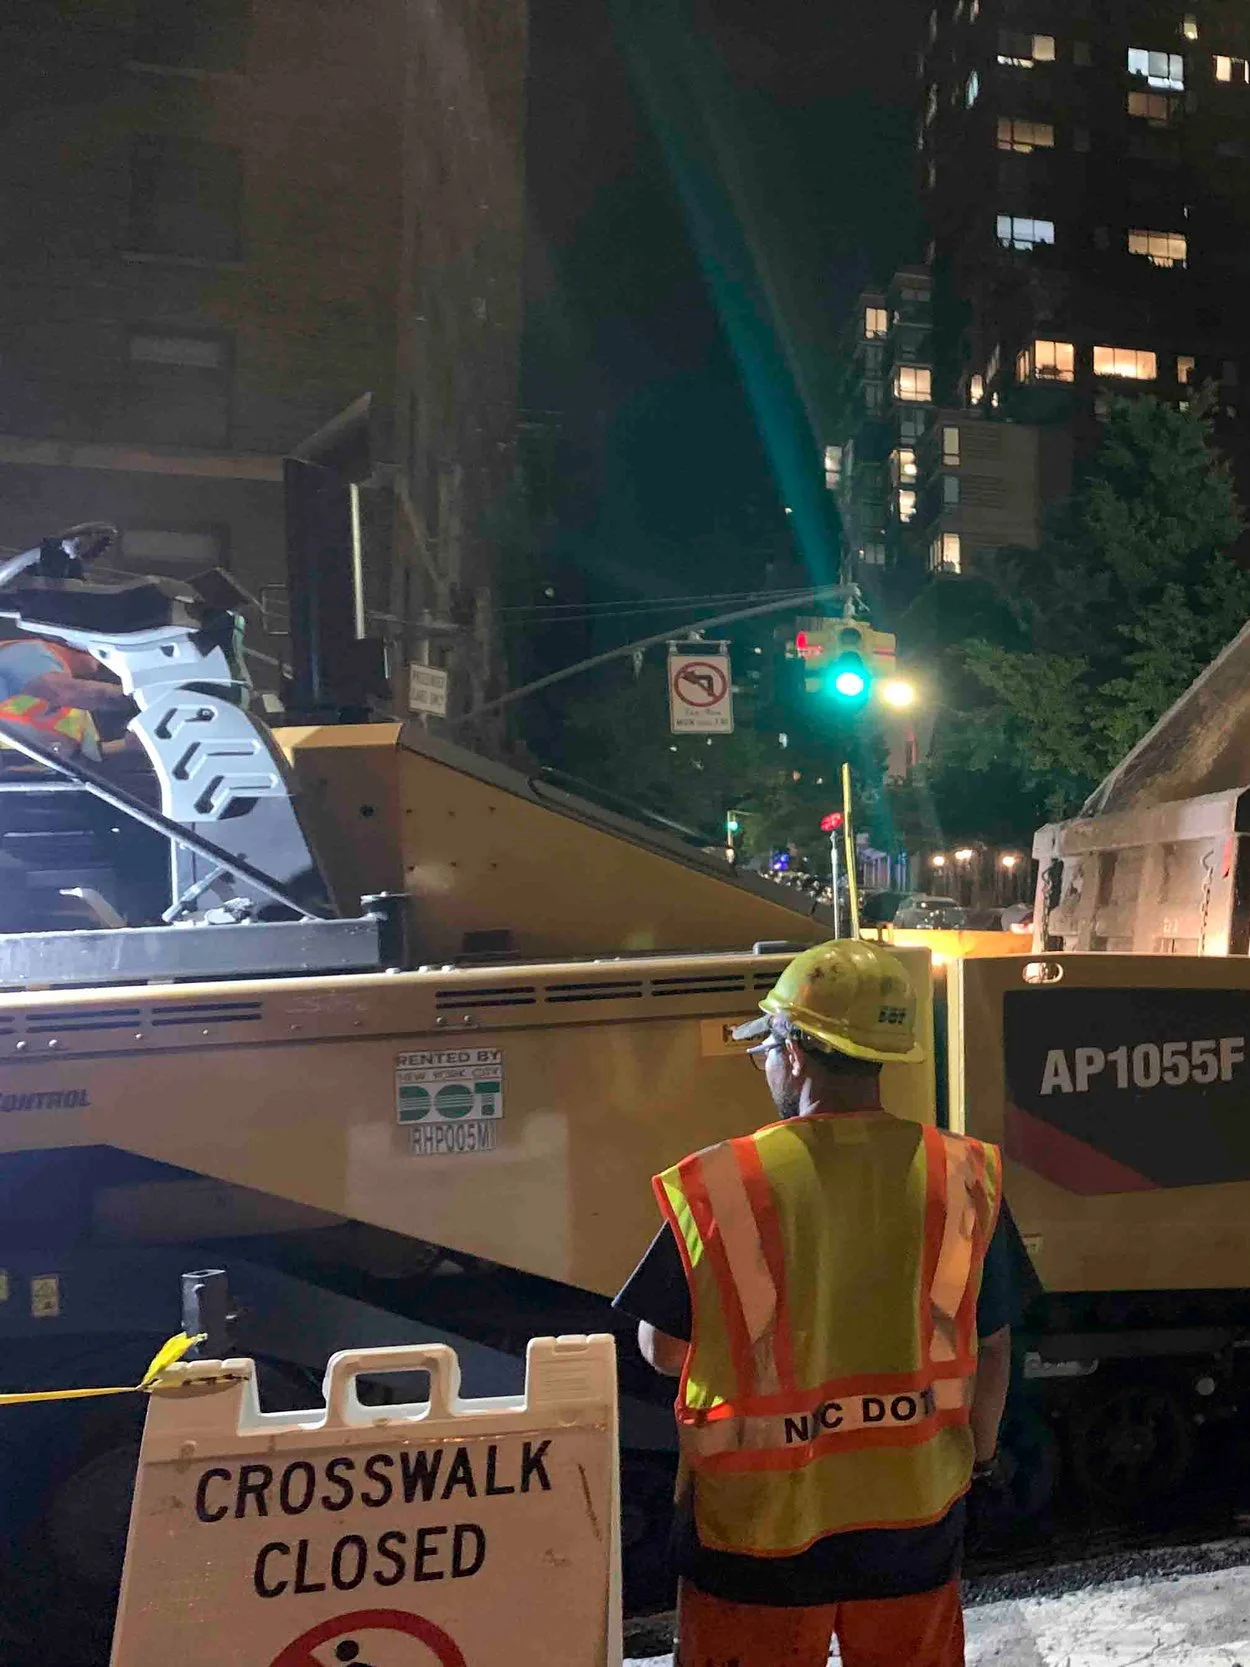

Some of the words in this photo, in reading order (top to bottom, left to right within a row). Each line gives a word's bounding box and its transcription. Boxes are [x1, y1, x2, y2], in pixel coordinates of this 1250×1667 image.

[396, 1052, 471, 1066] RENTED
[477, 1050, 498, 1062] BY
[1039, 1036, 1245, 1095] AP1055F
[399, 1081, 501, 1121] DOT
[196, 1439, 553, 1523] CROSSWALK
[253, 1523, 487, 1598] CLOSED
